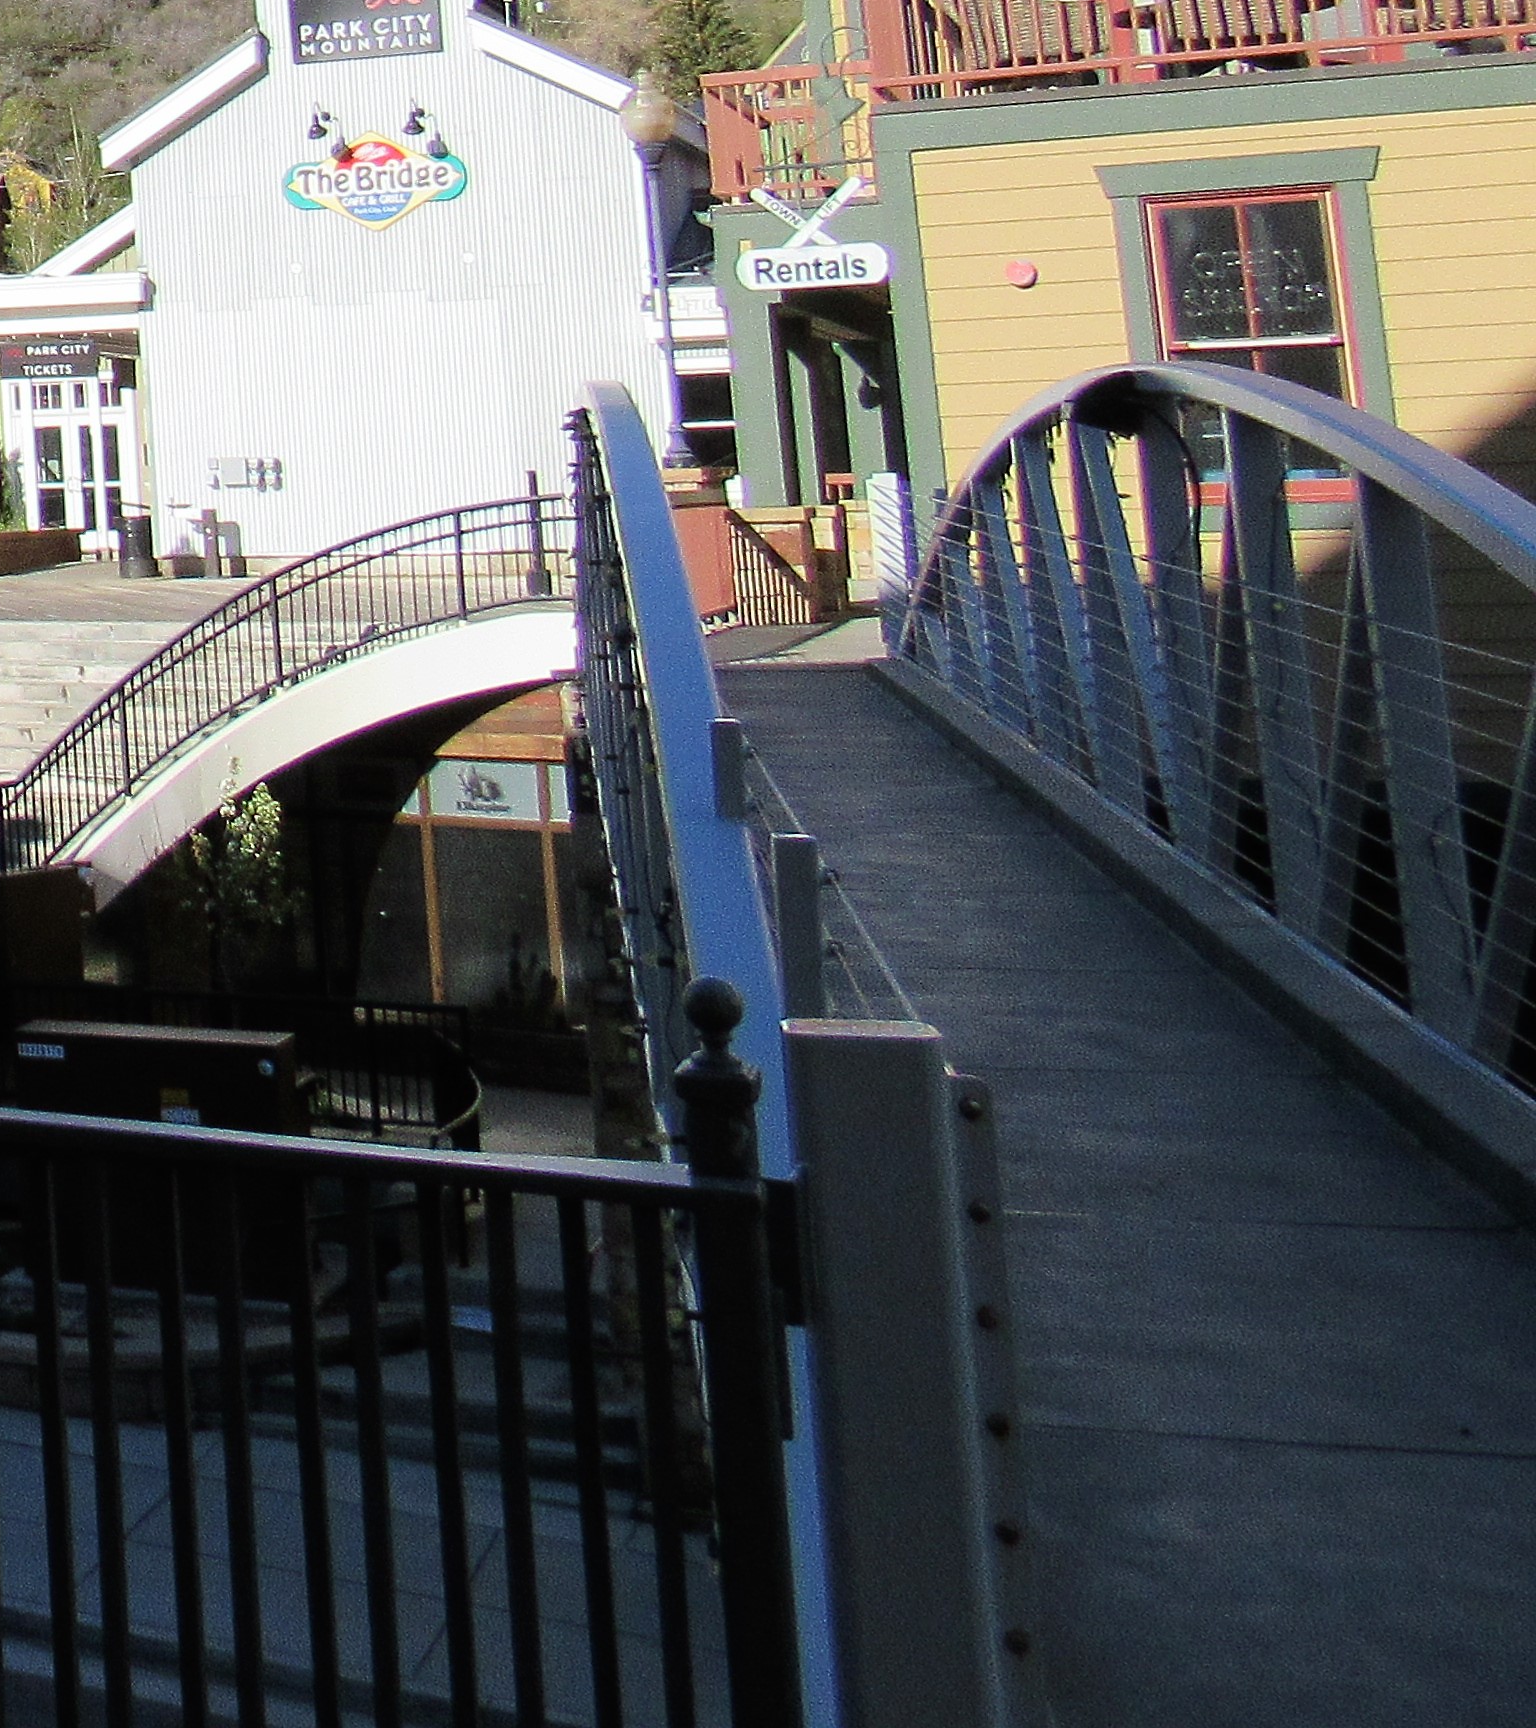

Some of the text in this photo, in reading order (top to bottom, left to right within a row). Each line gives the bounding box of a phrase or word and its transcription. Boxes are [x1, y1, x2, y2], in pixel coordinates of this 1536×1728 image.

[299, 13, 431, 42] PARK CITY
[301, 32, 432, 56] MOUNTAIN
[297, 162, 449, 195] The Bridge
[765, 195, 801, 226] TOWN
[753, 253, 868, 285] Rentals
[26, 344, 90, 356] PARK CITY
[22, 364, 73, 376] TICKETS
